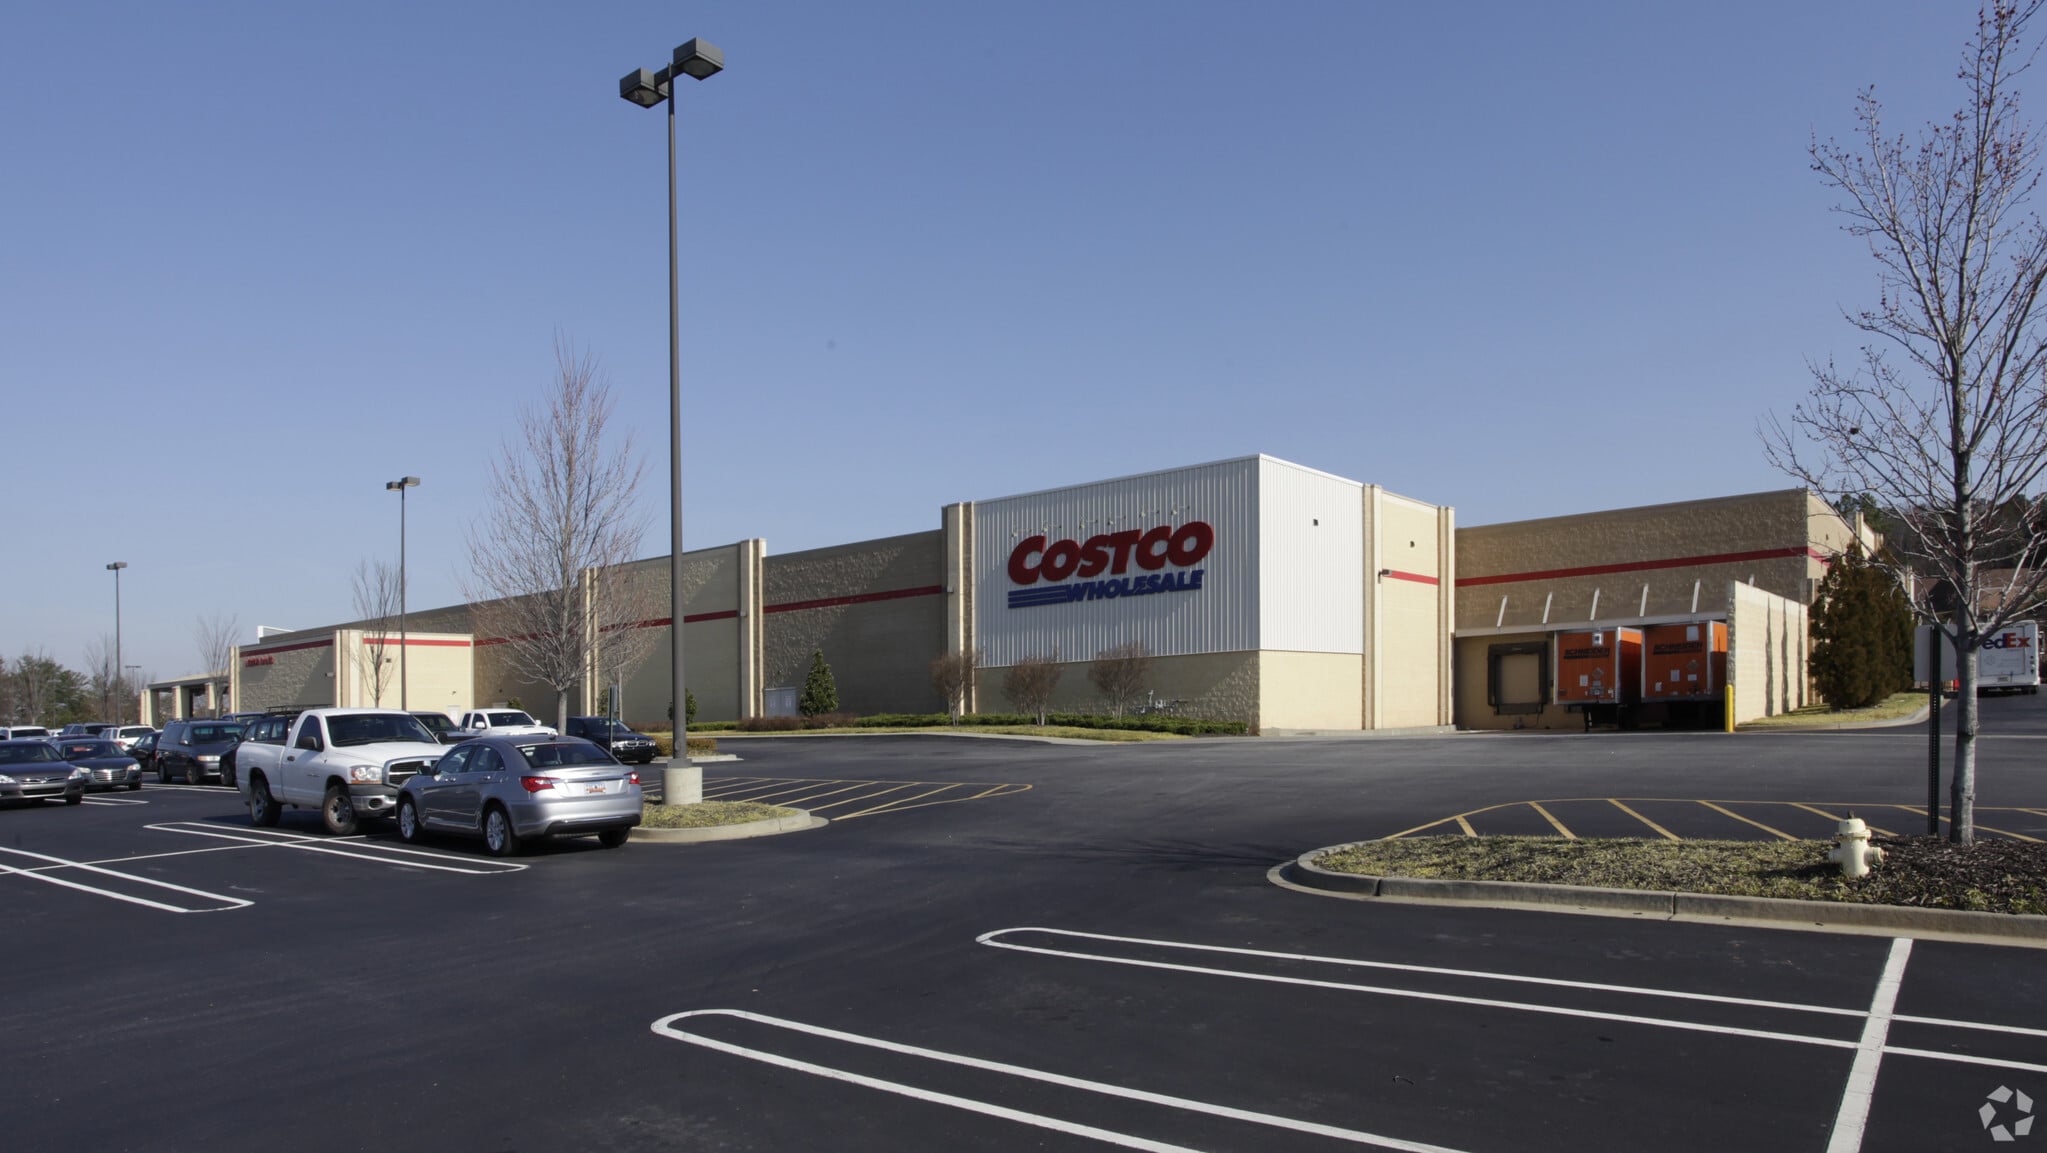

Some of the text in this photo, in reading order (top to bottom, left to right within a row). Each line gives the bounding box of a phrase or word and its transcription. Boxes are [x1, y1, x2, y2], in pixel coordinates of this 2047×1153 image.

[1008, 521, 1214, 585] COSTCO
[1066, 570, 1204, 602] WHOLESALE
[1982, 632, 2032, 649] edEx
